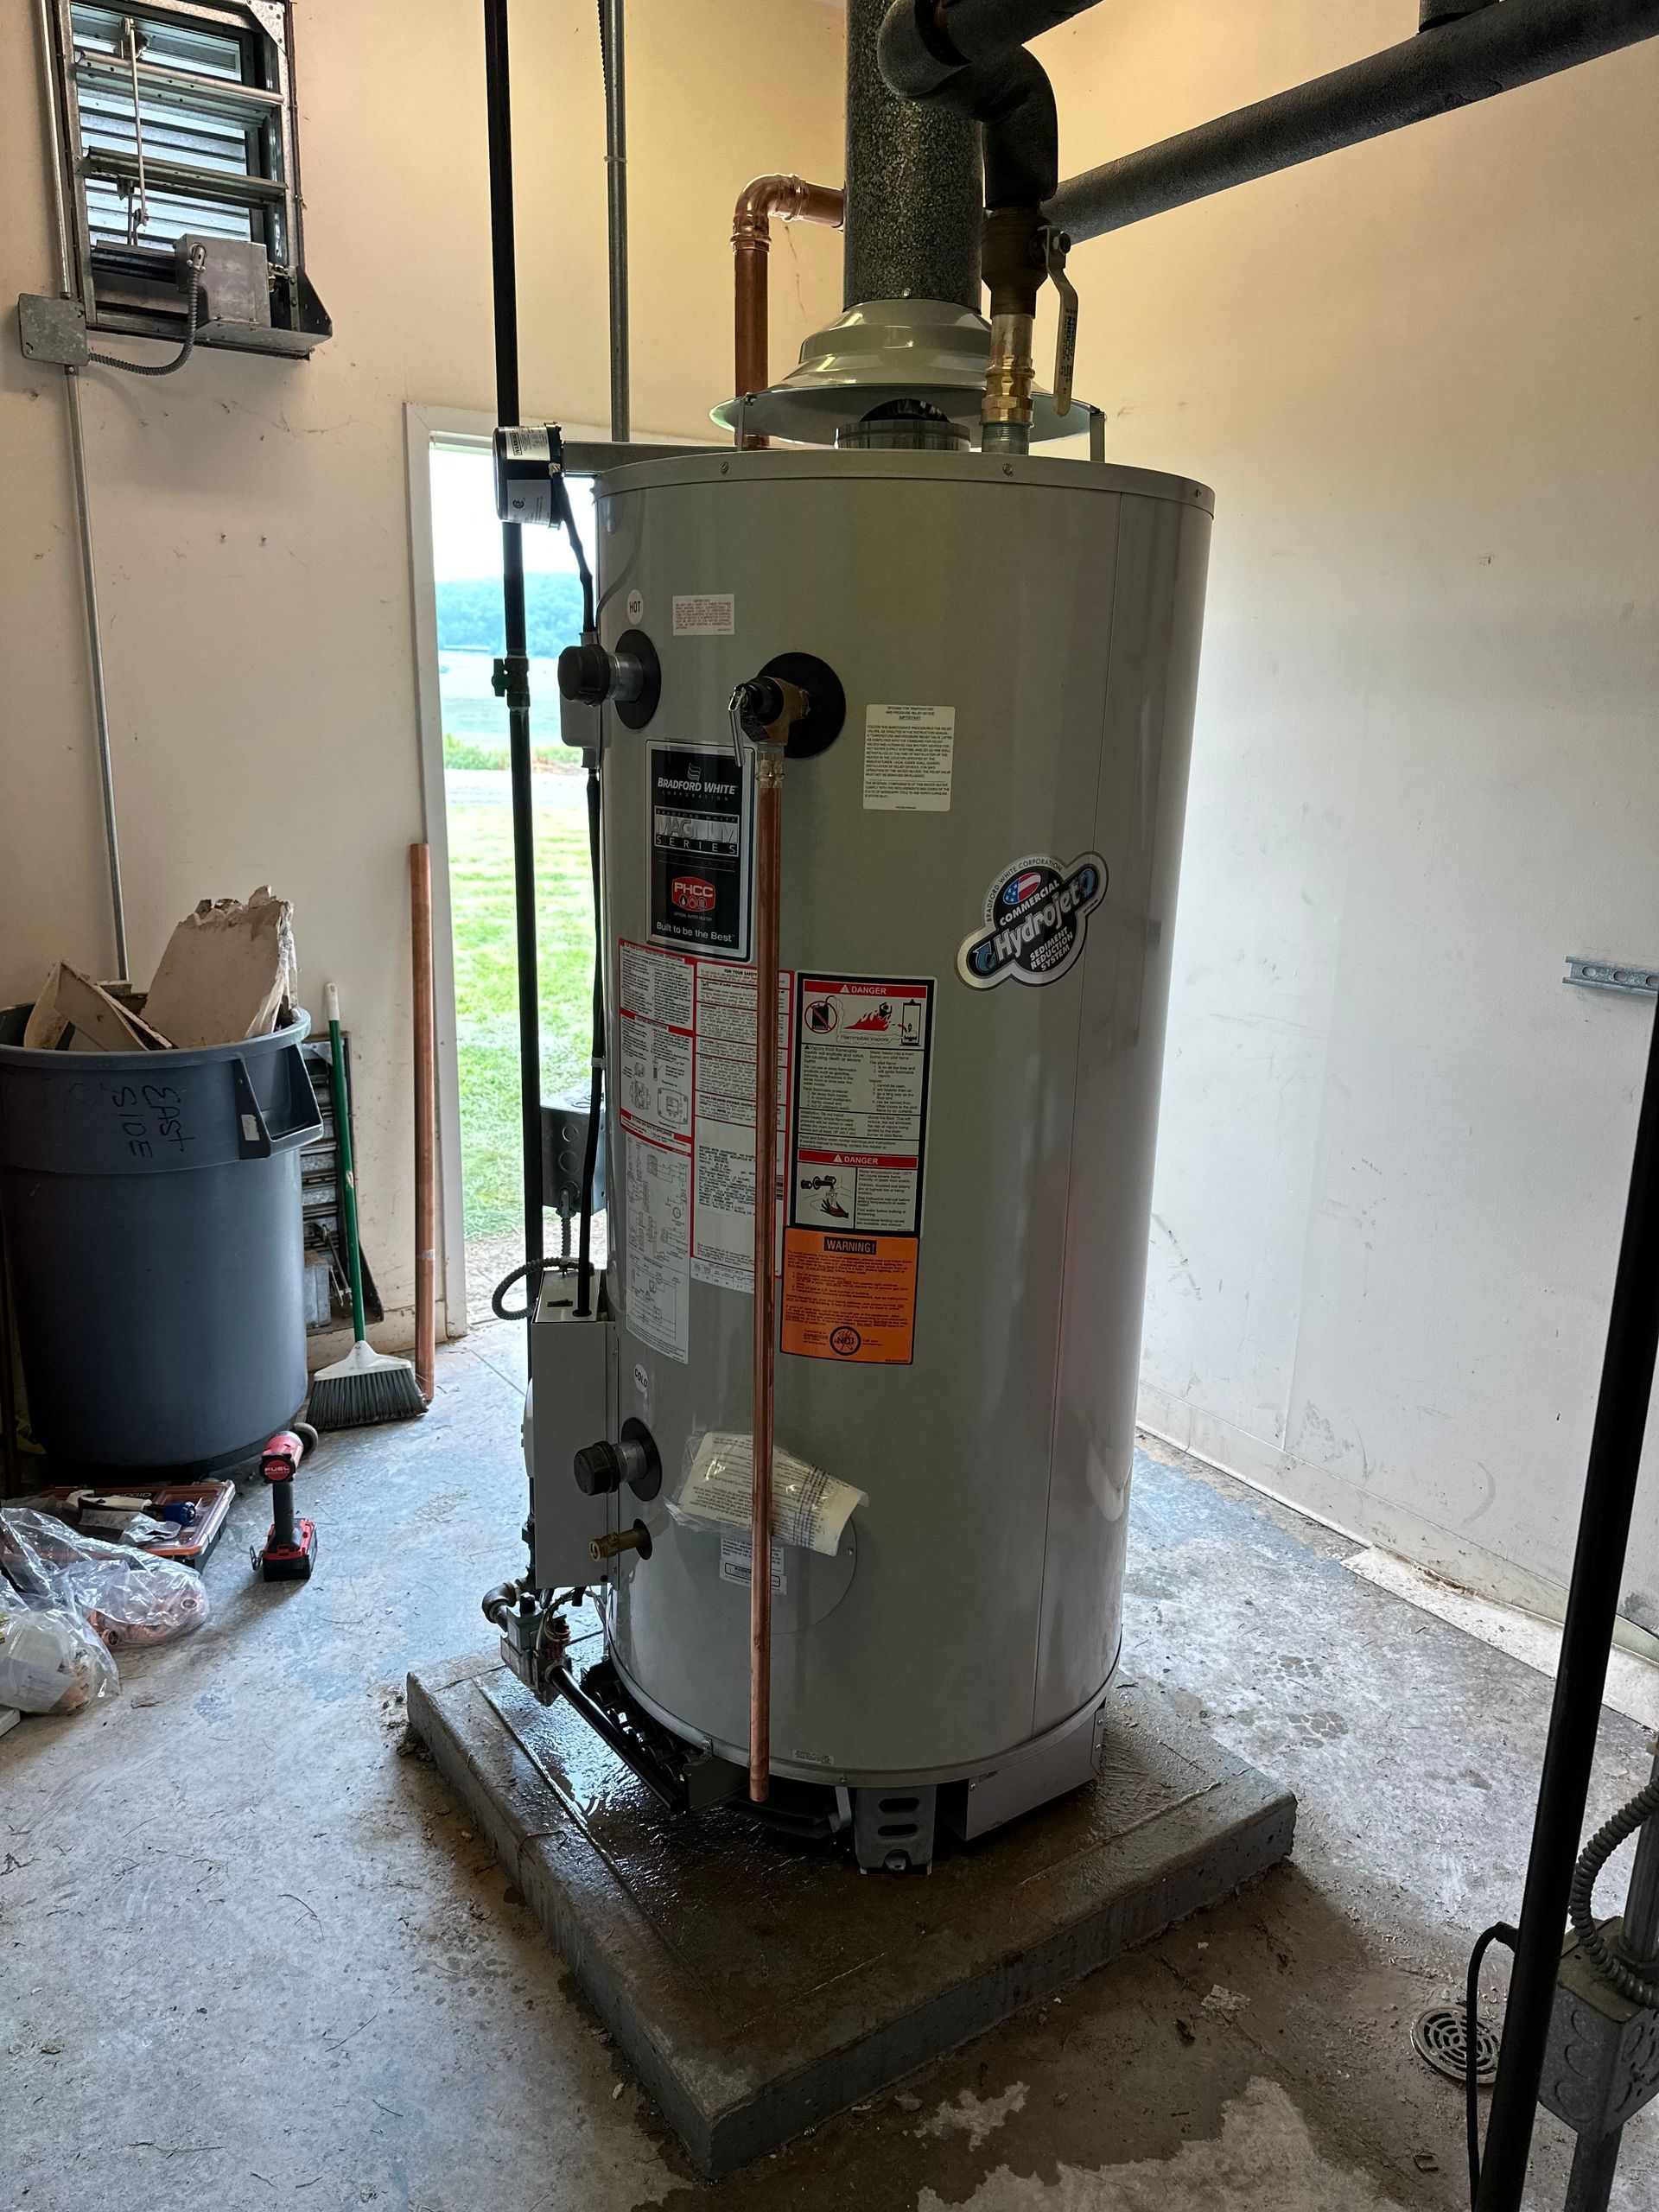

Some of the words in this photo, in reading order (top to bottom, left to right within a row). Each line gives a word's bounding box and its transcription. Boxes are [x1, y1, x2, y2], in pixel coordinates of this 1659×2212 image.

[629, 601, 641, 613] HOT
[658, 777, 702, 791] BRADFORD
[703, 782, 735, 795] WHITE
[657, 817, 738, 843] MAGNUM
[656, 836, 736, 855] SERIES
[674, 881, 714, 898] PHCC
[987, 884, 1000, 923] BRADFORD
[999, 866, 1018, 884] WHITE
[1019, 858, 1063, 872] CORPORATION
[1000, 880, 1060, 926] COMMERCIAL
[994, 877, 1080, 961] Hydrojet
[657, 921, 671, 933] Built
[673, 924, 681, 934] to
[683, 925, 693, 937] be
[695, 927, 709, 939] the
[710, 930, 732, 943] Best
[1030, 925, 1068, 961] SEDIMENT
[1030, 931, 1073, 969] REDUCTION
[1041, 944, 1070, 971] SYSTEM
[851, 986, 887, 995] DANGER
[112, 1086, 153, 1158] SIDE
[844, 1156, 879, 1165] DANGER
[826, 1239, 875, 1253] WARNING!
[635, 1368, 648, 1388] COLD
